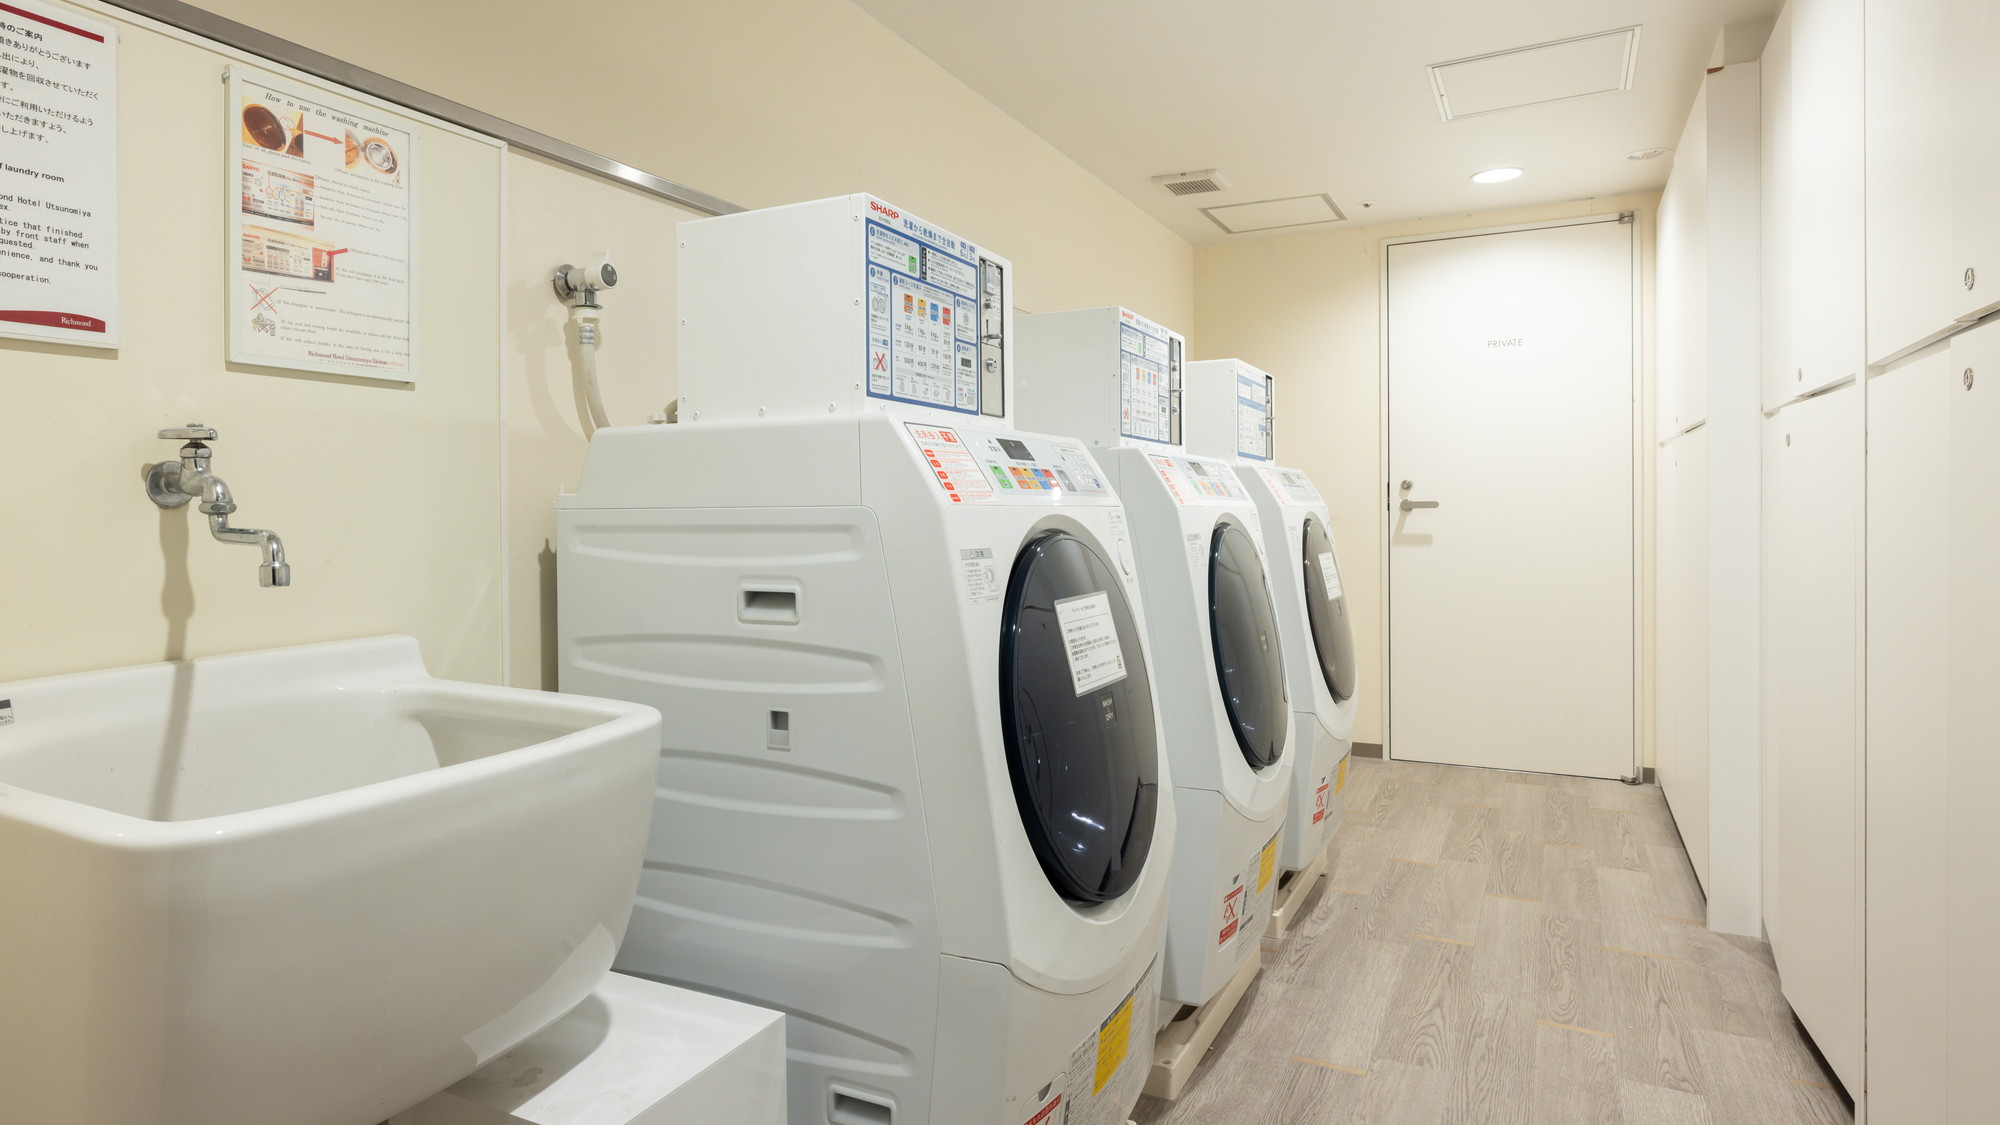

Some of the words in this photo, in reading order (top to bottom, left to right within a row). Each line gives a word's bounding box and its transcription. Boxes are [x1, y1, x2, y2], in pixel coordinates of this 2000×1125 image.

[265, 92, 282, 103] How
[298, 104, 310, 112] use
[315, 109, 327, 118] the
[331, 115, 359, 129] washing
[362, 124, 389, 137] machine
[5, 163, 39, 178] laundry
[41, 173, 64, 183] room
[17, 196, 40, 207] Hotel
[45, 202, 91, 217] Utsunomiya
[870, 201, 900, 219] SHARP
[1, 227, 11, 236] by
[16, 229, 39, 240] front
[44, 236, 67, 245] staff
[71, 240, 89, 249] when
[23, 221, 41, 231] that
[46, 226, 83, 239] finished
[39, 256, 54, 264] and
[58, 258, 81, 268] thank
[61, 316, 91, 326] Richmond
[1487, 338, 1523, 348] PRIVATE
[308, 350, 332, 359] Richmond
